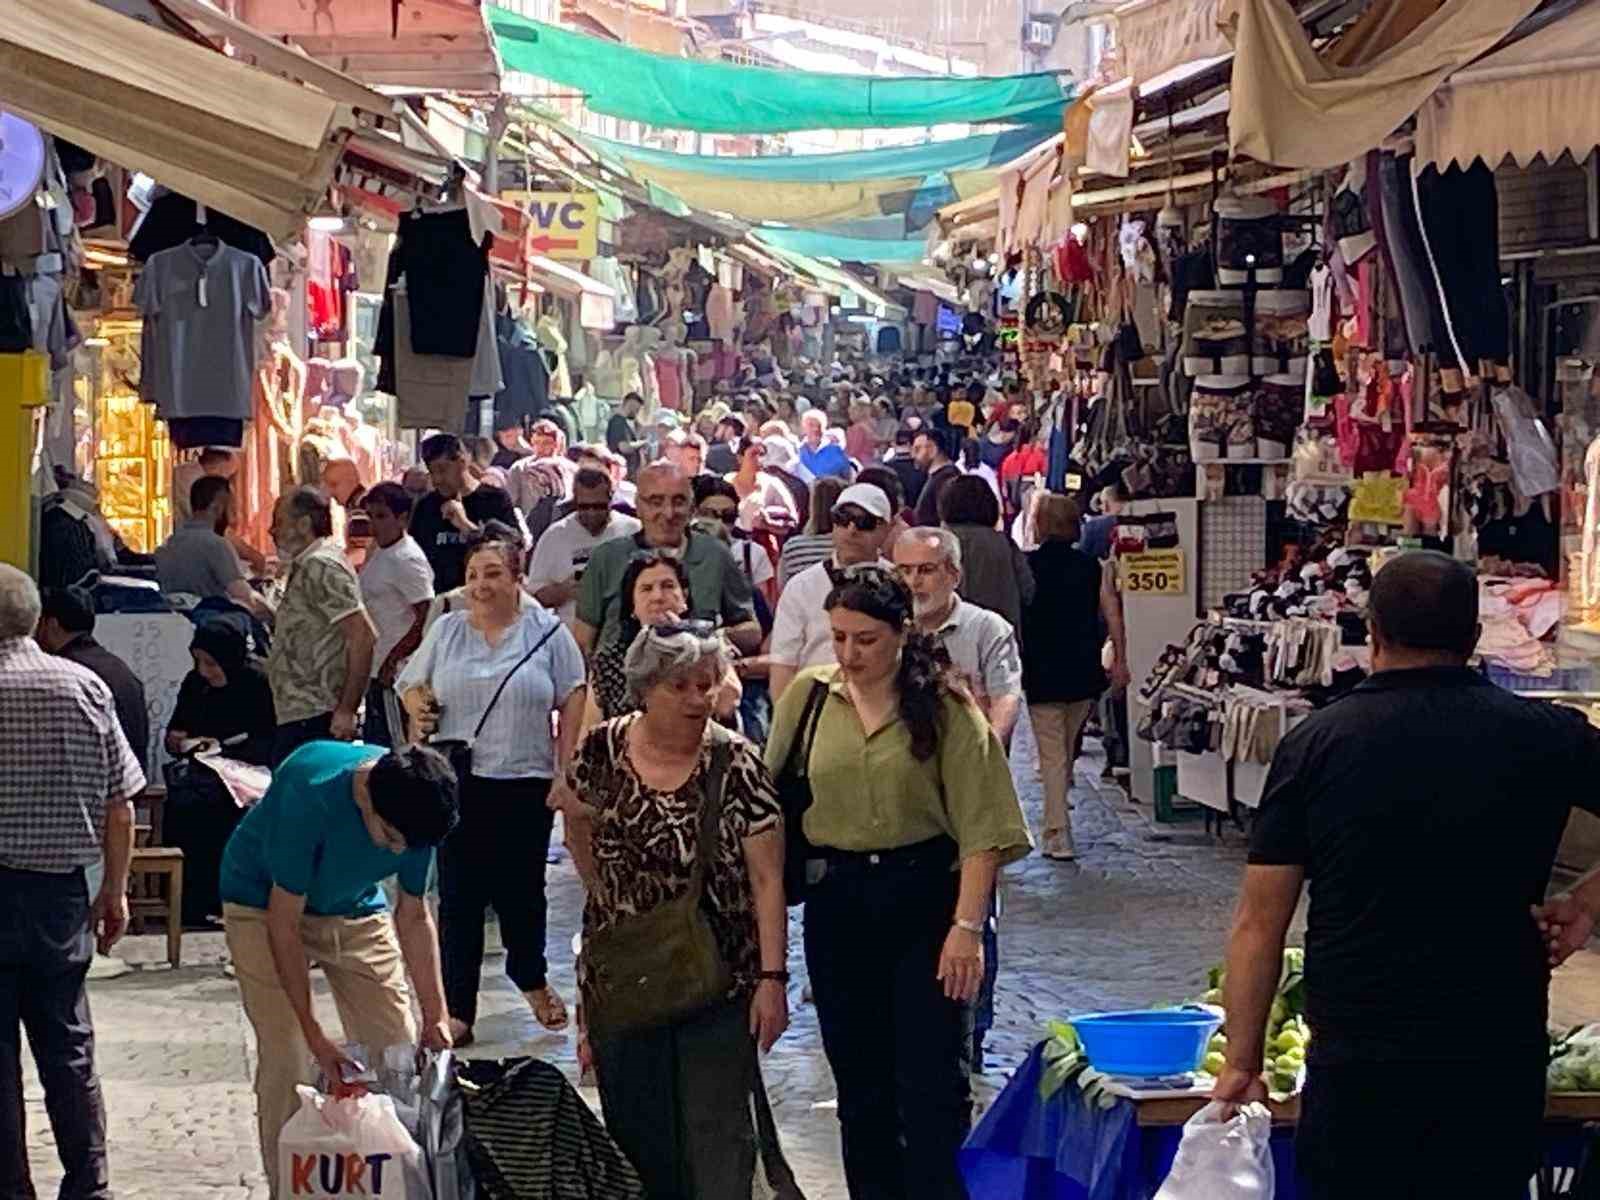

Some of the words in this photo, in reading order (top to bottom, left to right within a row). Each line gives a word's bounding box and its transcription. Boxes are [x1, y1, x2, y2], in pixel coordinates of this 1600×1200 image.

[515, 200, 585, 230] WC
[1128, 572, 1168, 591] 350
[133, 620, 161, 639] 25
[291, 1152, 393, 1195] KURT
